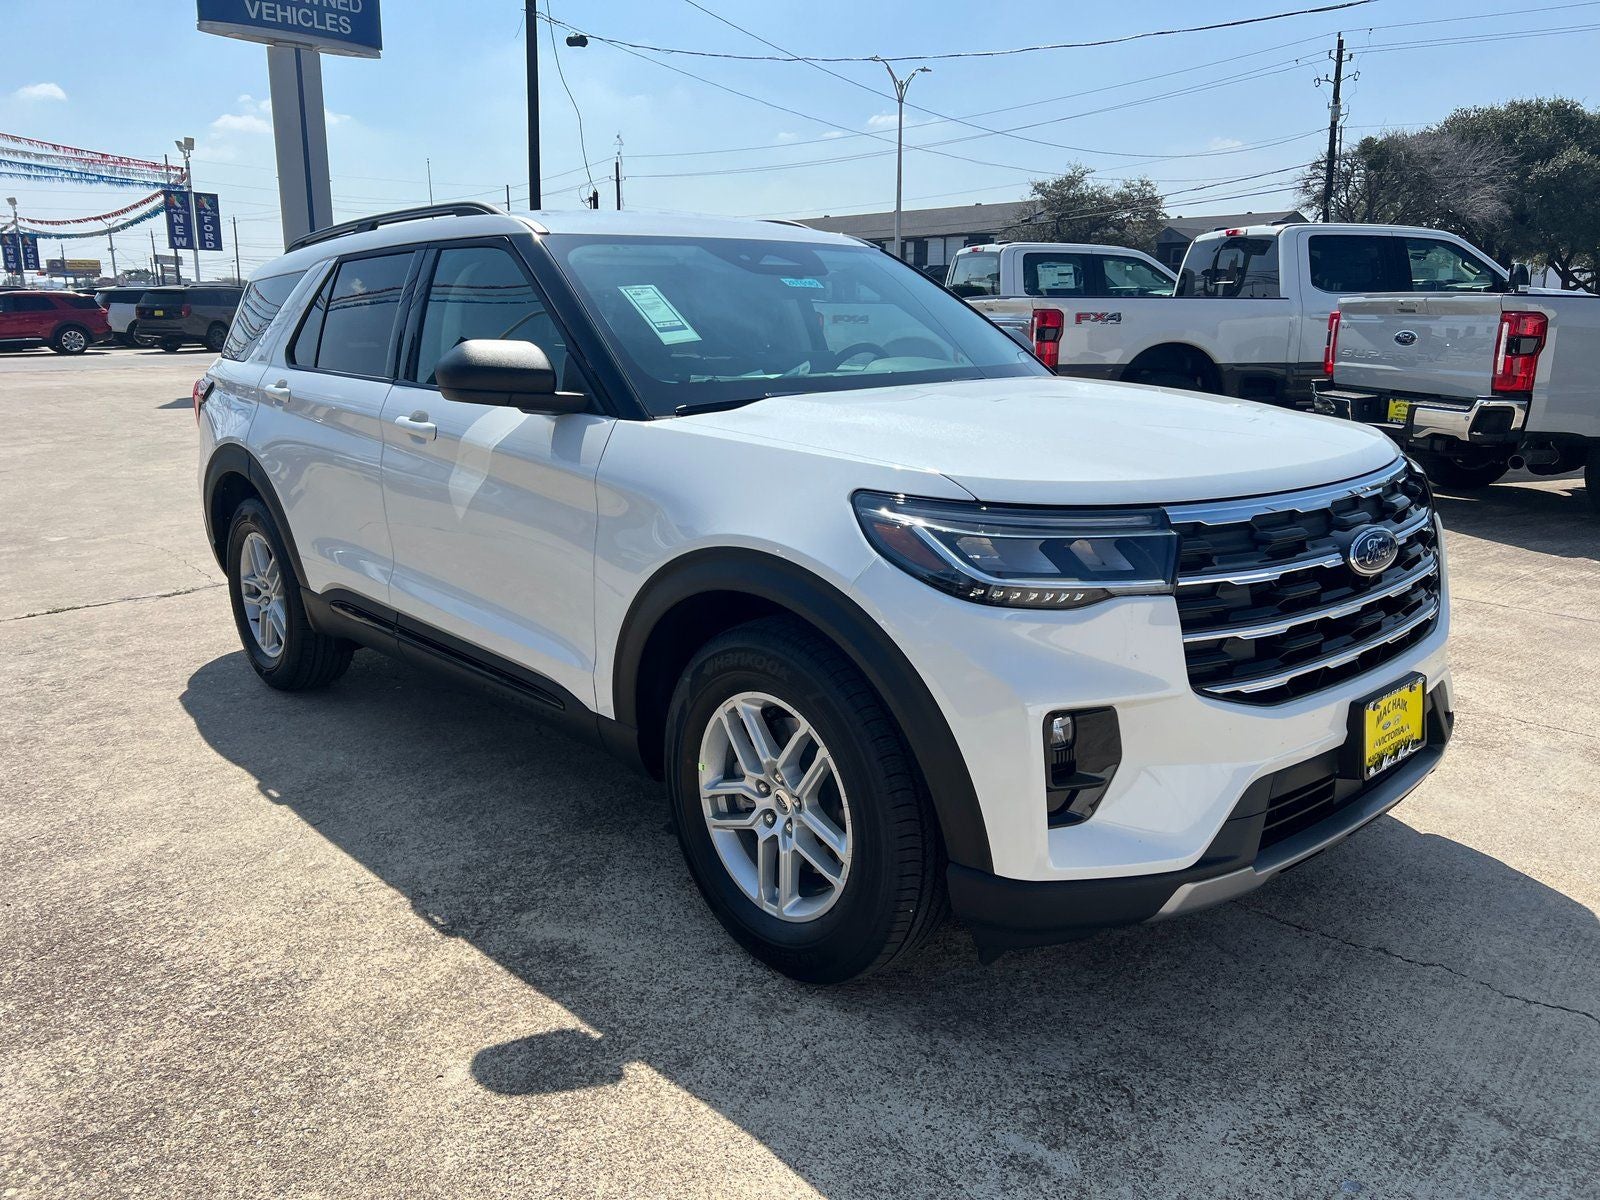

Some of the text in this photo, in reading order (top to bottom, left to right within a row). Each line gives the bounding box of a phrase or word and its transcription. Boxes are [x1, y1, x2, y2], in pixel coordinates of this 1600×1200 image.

[244, 0, 352, 34] VEHICLES
[173, 213, 187, 247] NEW
[203, 215, 215, 249] FORD
[6, 248, 17, 269] NEW
[26, 248, 35, 269] FORD
[1075, 311, 1122, 324] FX4
[1341, 348, 1409, 361] SUPER
